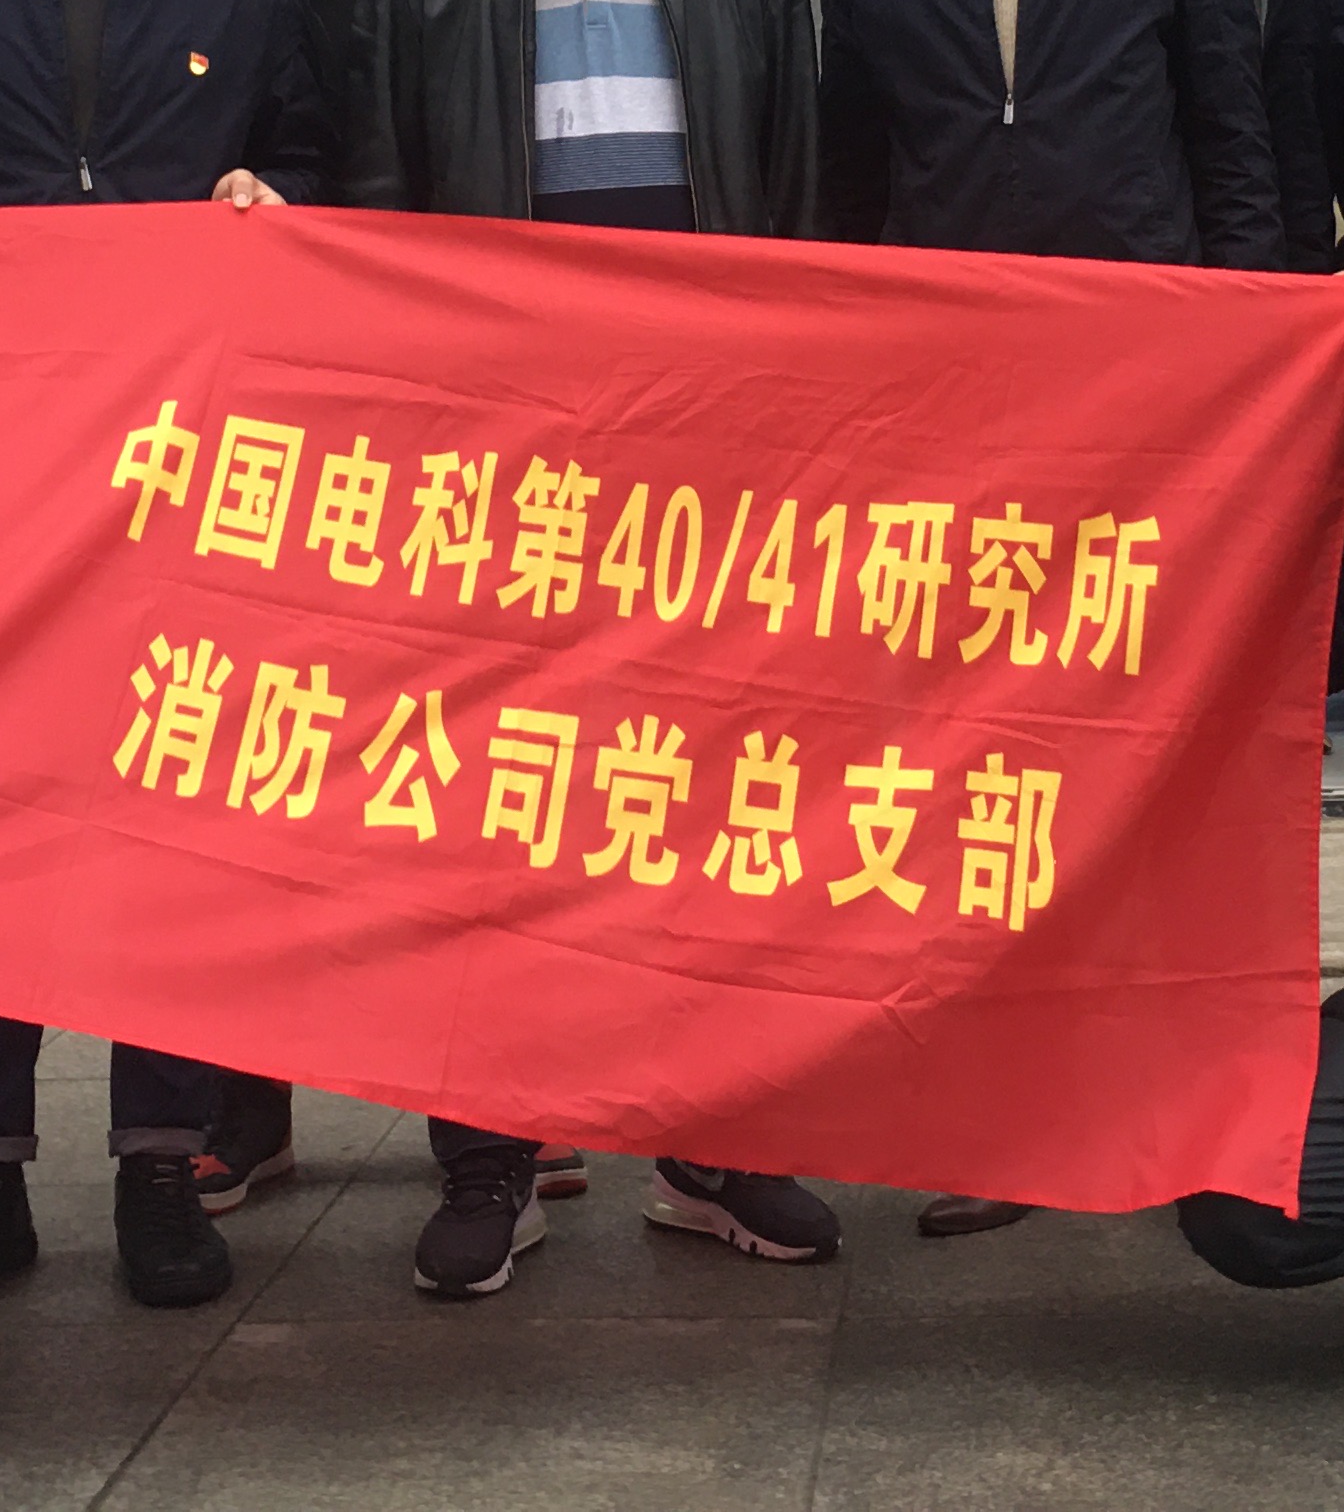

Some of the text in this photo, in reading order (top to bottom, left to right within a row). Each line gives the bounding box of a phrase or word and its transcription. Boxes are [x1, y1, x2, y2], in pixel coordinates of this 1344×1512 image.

[110, 398, 1163, 676] 中国电科第40/41研究所
[111, 632, 1063, 932] 消防公司党总支部
